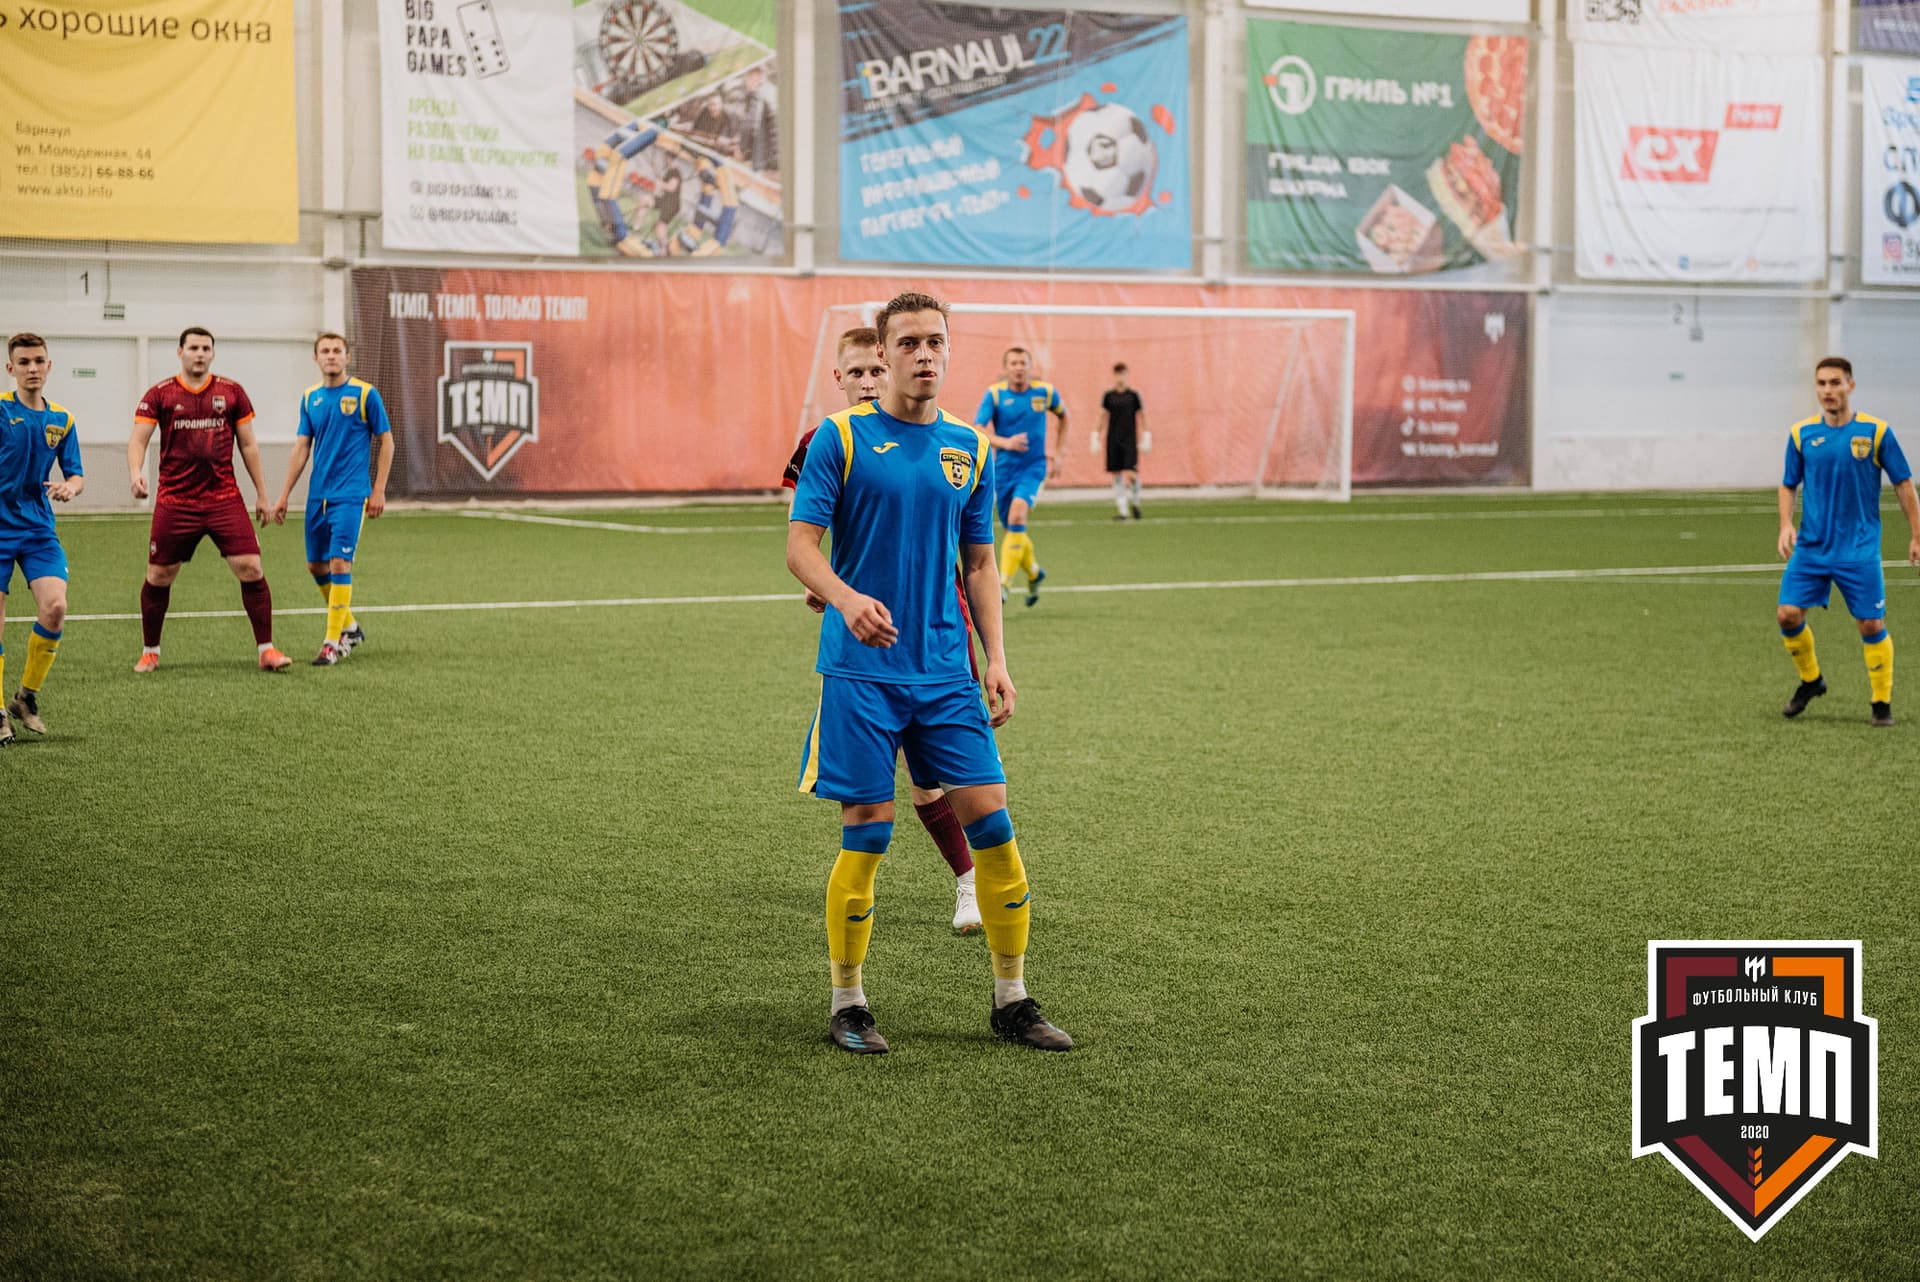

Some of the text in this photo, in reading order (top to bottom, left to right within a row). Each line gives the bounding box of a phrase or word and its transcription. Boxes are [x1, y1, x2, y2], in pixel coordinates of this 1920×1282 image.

[19, 6, 180, 40] хорошие
[191, 17, 272, 43] окна
[405, 0, 435, 21] BIG
[407, 26, 451, 49] PAPA
[407, 50, 467, 77] GAMES
[1324, 75, 1408, 106] ГРИЛЬ
[15, 120, 72, 138] Барнаул
[388, 292, 435, 322] ТЕМП,
[436, 293, 481, 323] ТЕМП,
[483, 294, 542, 320] ТОЛЬКО
[448, 379, 530, 428] ТЕМП
